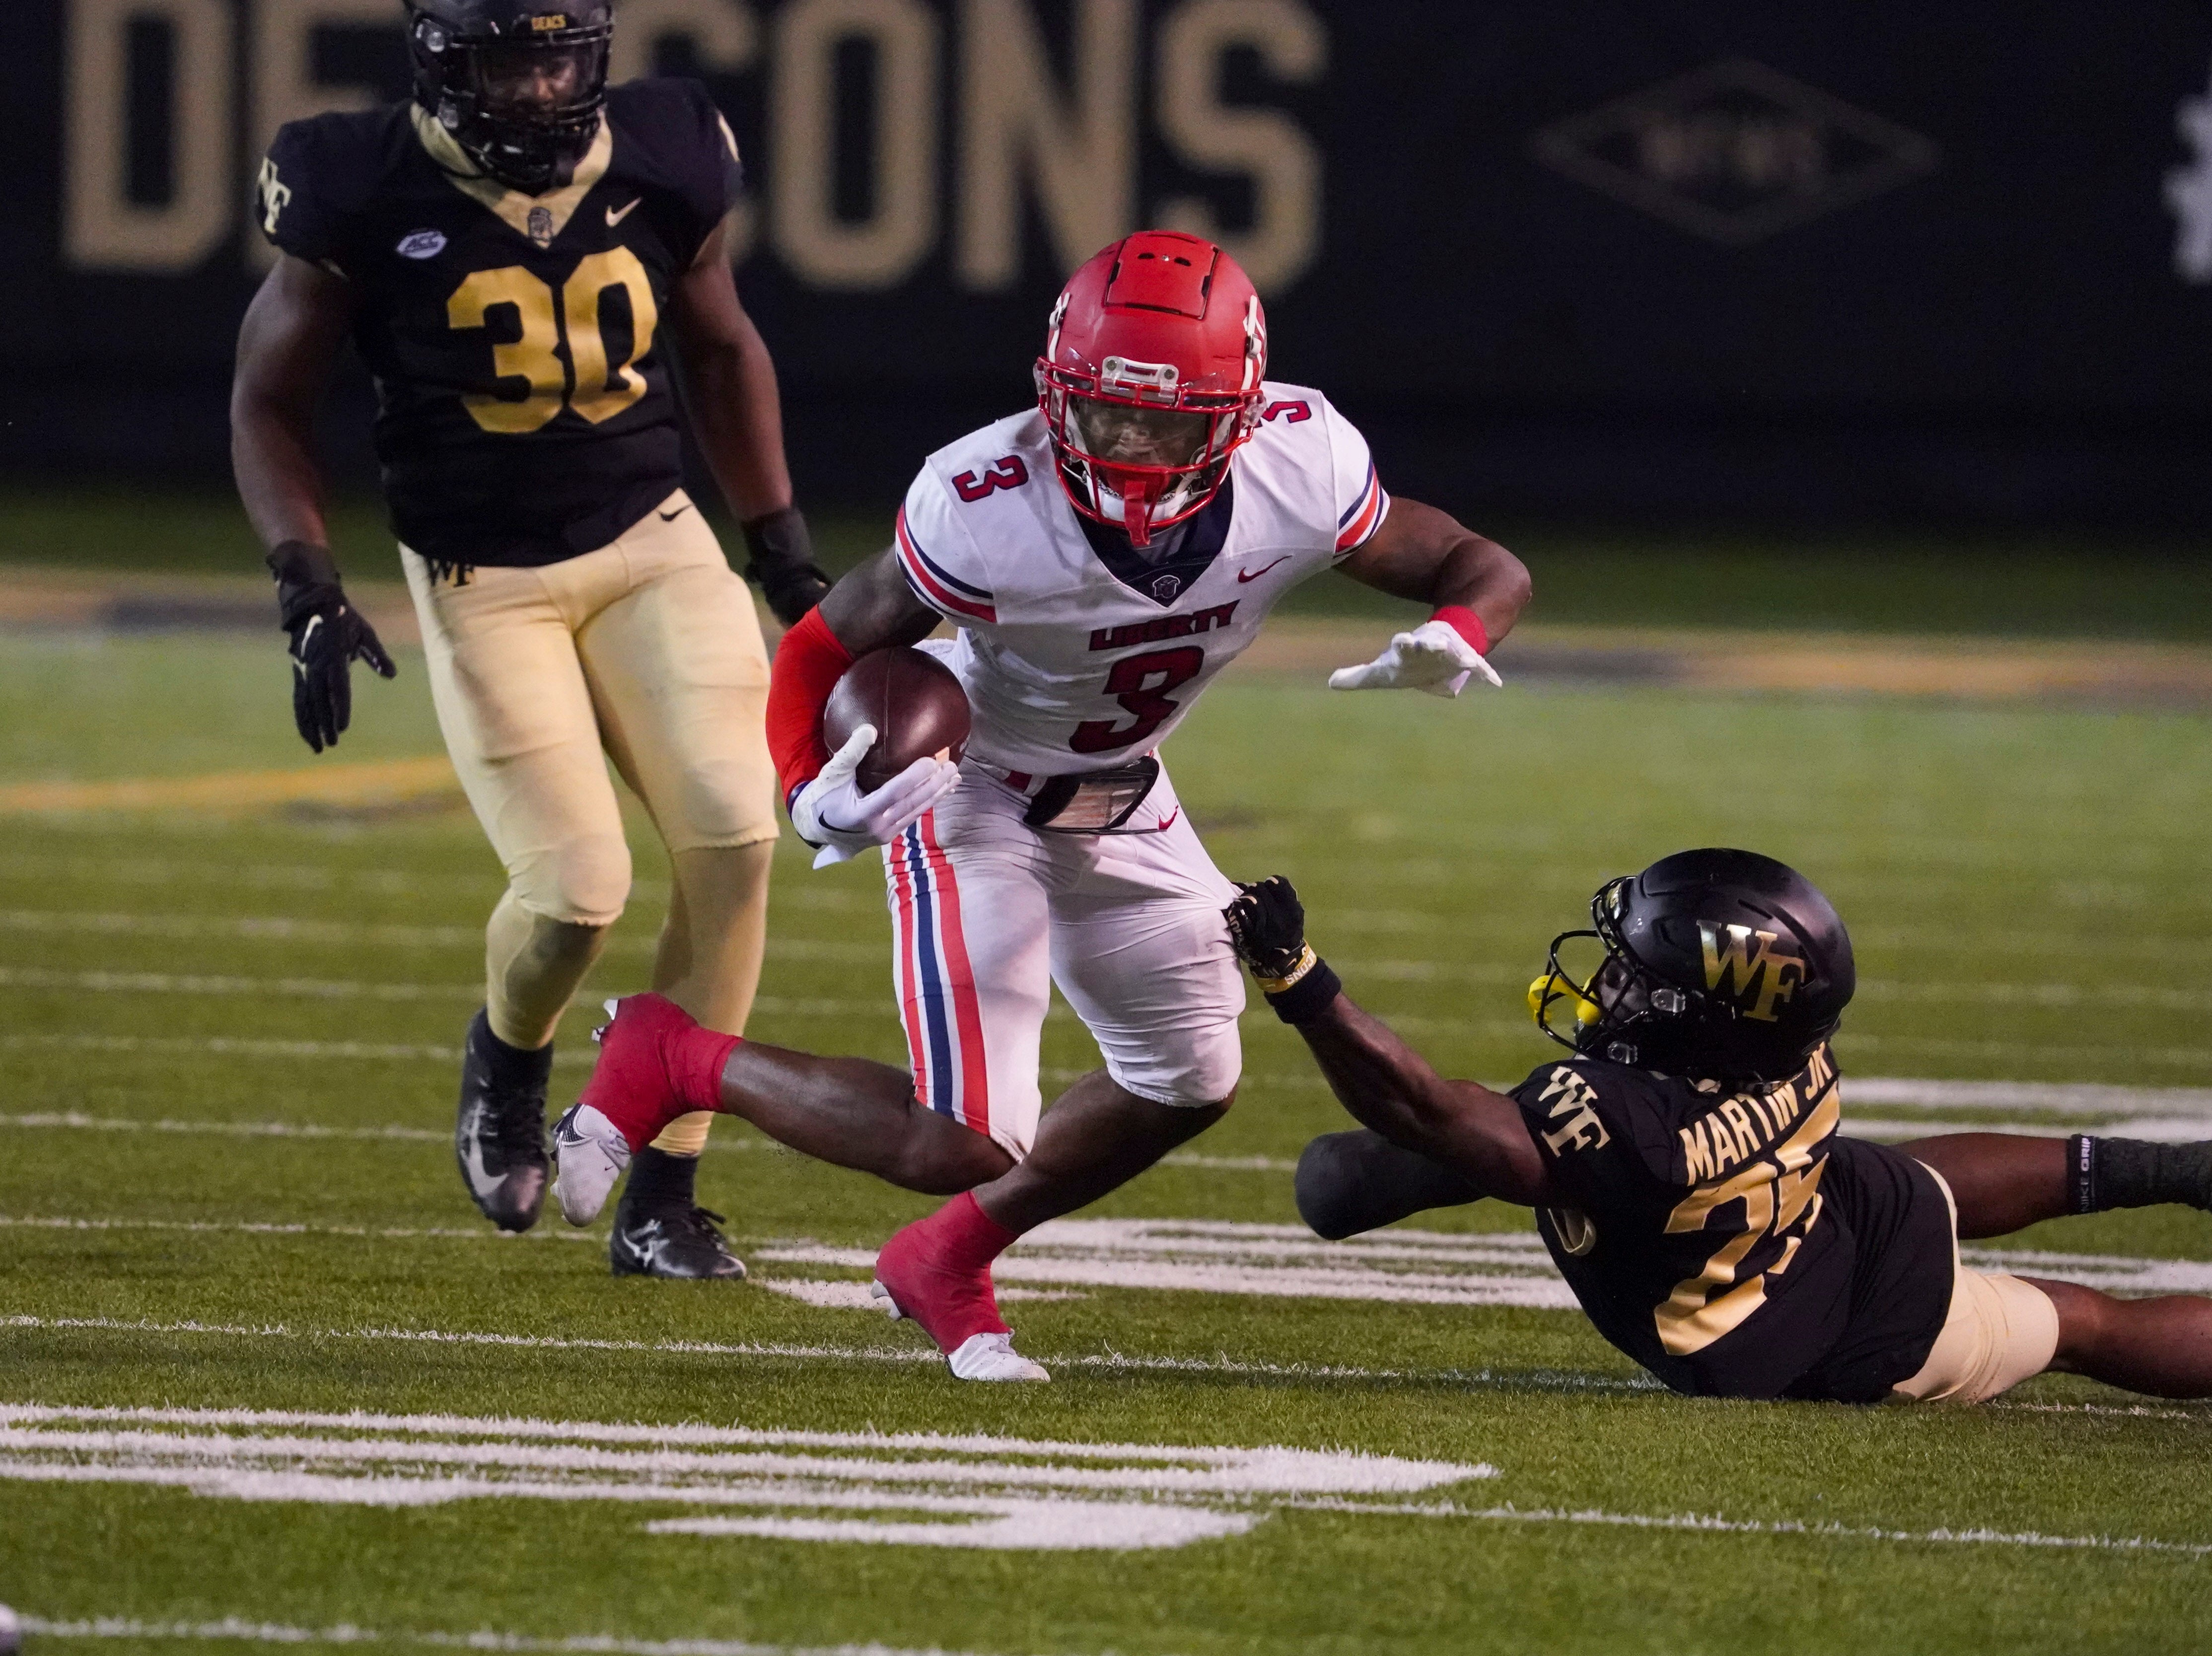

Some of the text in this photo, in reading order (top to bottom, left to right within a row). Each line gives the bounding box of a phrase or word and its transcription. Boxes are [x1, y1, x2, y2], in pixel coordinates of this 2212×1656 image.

[531, 15, 567, 31] DEACS
[258, 156, 292, 234] WF
[447, 245, 657, 433] 30
[951, 454, 1029, 503] 3
[1089, 599, 1241, 651] LIBERTY
[1069, 645, 1205, 754] 3
[1696, 919, 1805, 1022] WF
[1537, 1066, 1611, 1158] WF
[1678, 1080, 1799, 1187] MARTIN
[1654, 1080, 1841, 1357] 25
